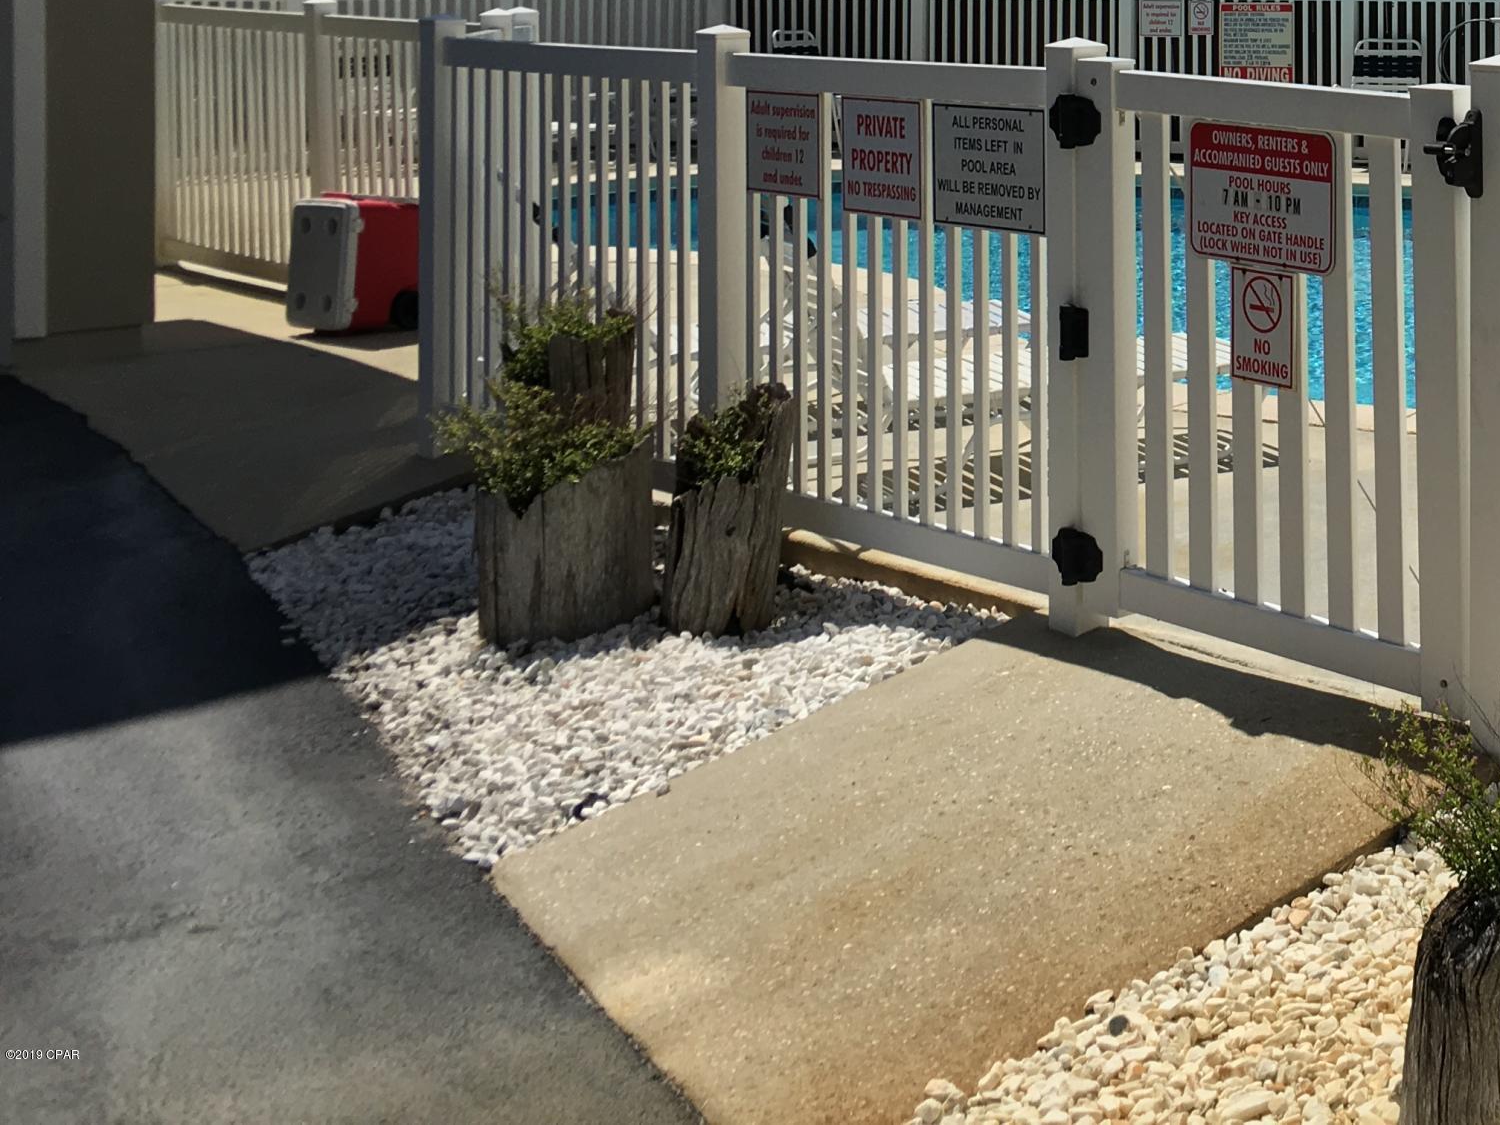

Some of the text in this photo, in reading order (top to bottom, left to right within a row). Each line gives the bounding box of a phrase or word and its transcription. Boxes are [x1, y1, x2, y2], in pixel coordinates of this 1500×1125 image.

[1224, 67, 1290, 83] NO DIVING
[751, 99, 816, 120] Adult supervision
[756, 123, 809, 142] is required for
[856, 113, 906, 139] PRIVATE
[952, 115, 1024, 132] ALL PERSONAL
[954, 137, 1023, 154] ITEMS LEFT IN
[1212, 130, 1309, 154] OWNERS, RENTERS &
[762, 145, 804, 163] children 12
[851, 147, 912, 175] PROPERTY
[1193, 148, 1329, 177] ACCOMPANIED GUESTS ONLY
[763, 168, 778, 184] and
[961, 158, 1017, 176] POOL AREA
[847, 179, 917, 202] NO TRESPASSING
[937, 178, 1041, 201] WILL BE REMOVED BY
[1229, 176, 1291, 195] POOL HOURS
[955, 201, 1023, 221] MANAGEMENT
[1223, 189, 1229, 206] 7
[1233, 190, 1248, 208] AM
[1268, 195, 1281, 212] 10
[1286, 198, 1301, 215] PM
[1233, 211, 1287, 230] KEY ACCESS
[1197, 220, 1325, 250] LOCATED ON GATE HANDLE
[1200, 235, 1322, 268] (LOCK WHEN NOT IN USE)
[1254, 338, 1271, 356] NO
[1236, 355, 1289, 379] SMOKING
